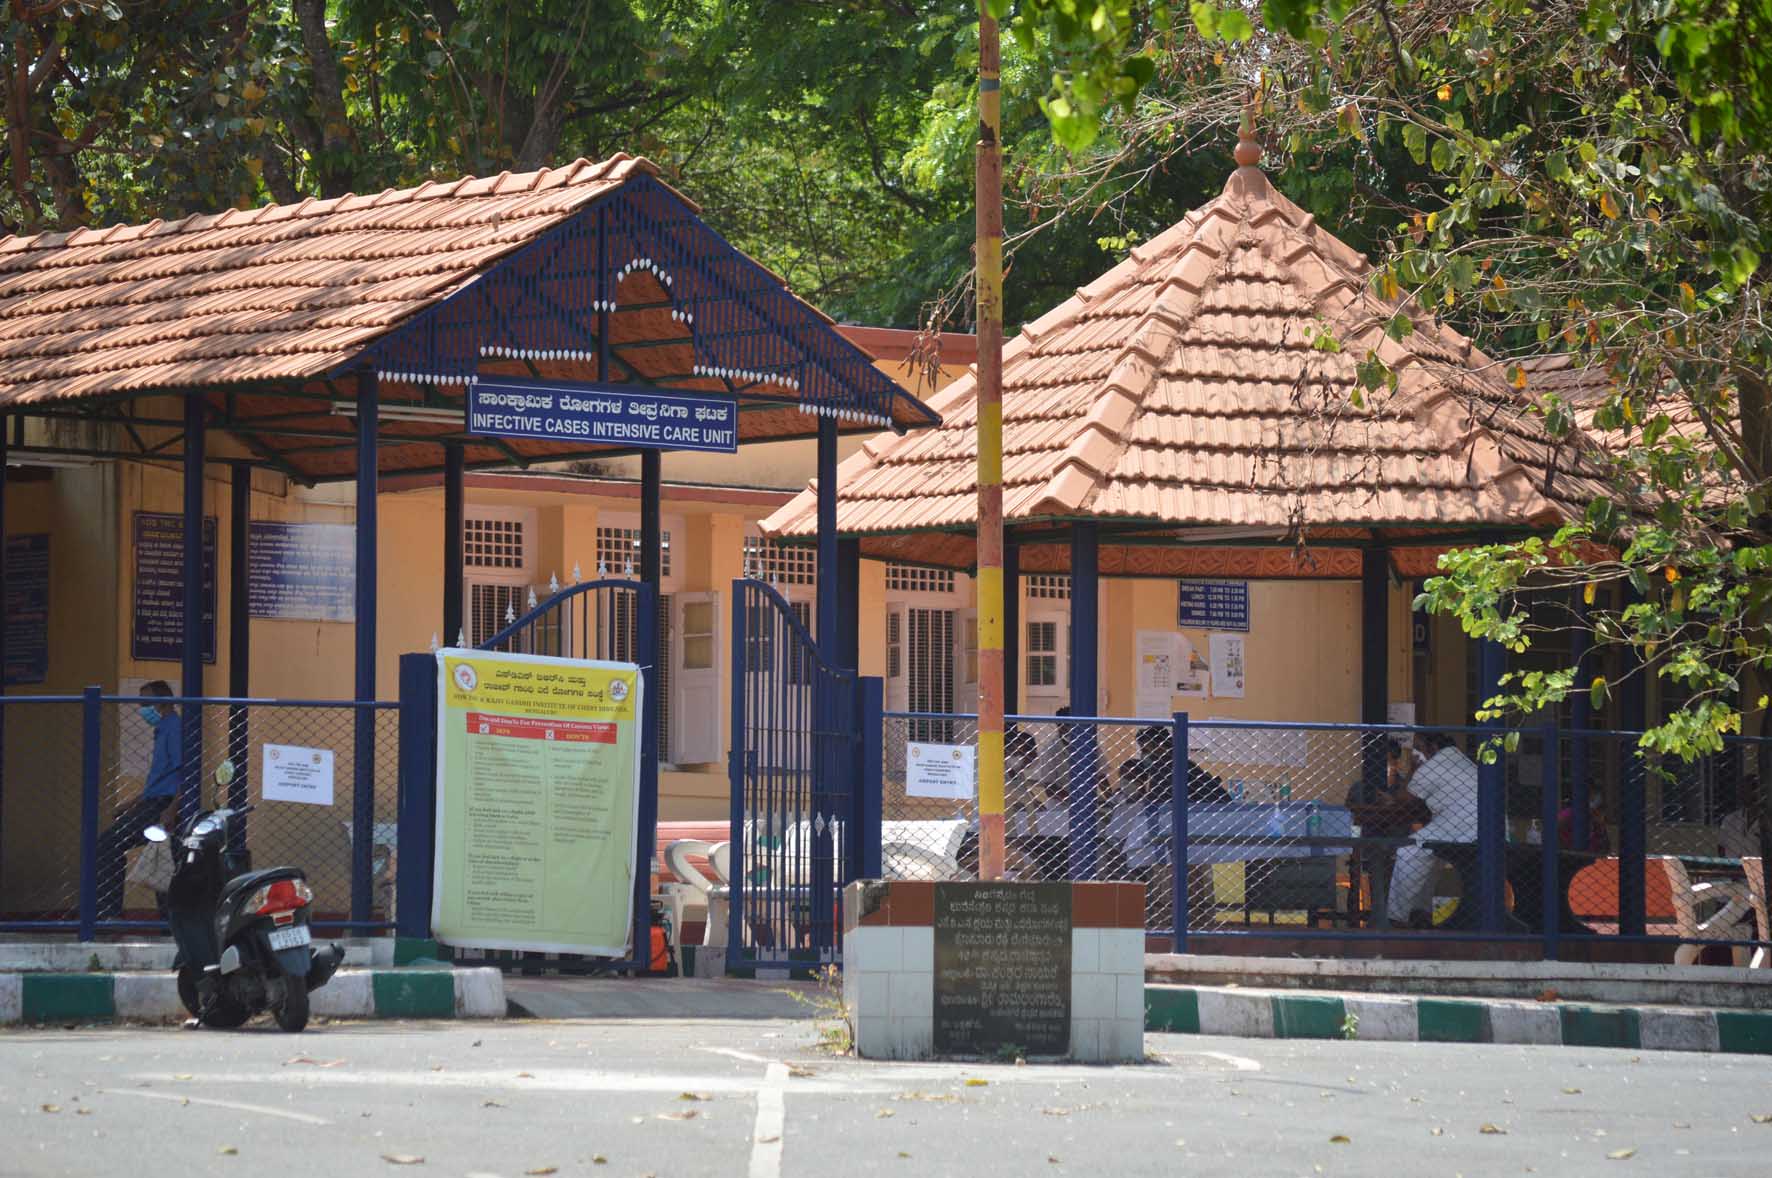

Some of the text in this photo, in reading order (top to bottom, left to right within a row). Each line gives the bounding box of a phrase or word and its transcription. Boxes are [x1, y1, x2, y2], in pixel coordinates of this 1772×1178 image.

[478, 392, 728, 421] ಸಾಂಕ್ರಾಮಿಕ ರೋಗಗಳ ತೀವ್ರ ನಿಗಾ ಘಟಕ
[473, 413, 733, 444] INFECTIVE CASES INTENSIVE CARE UNIT
